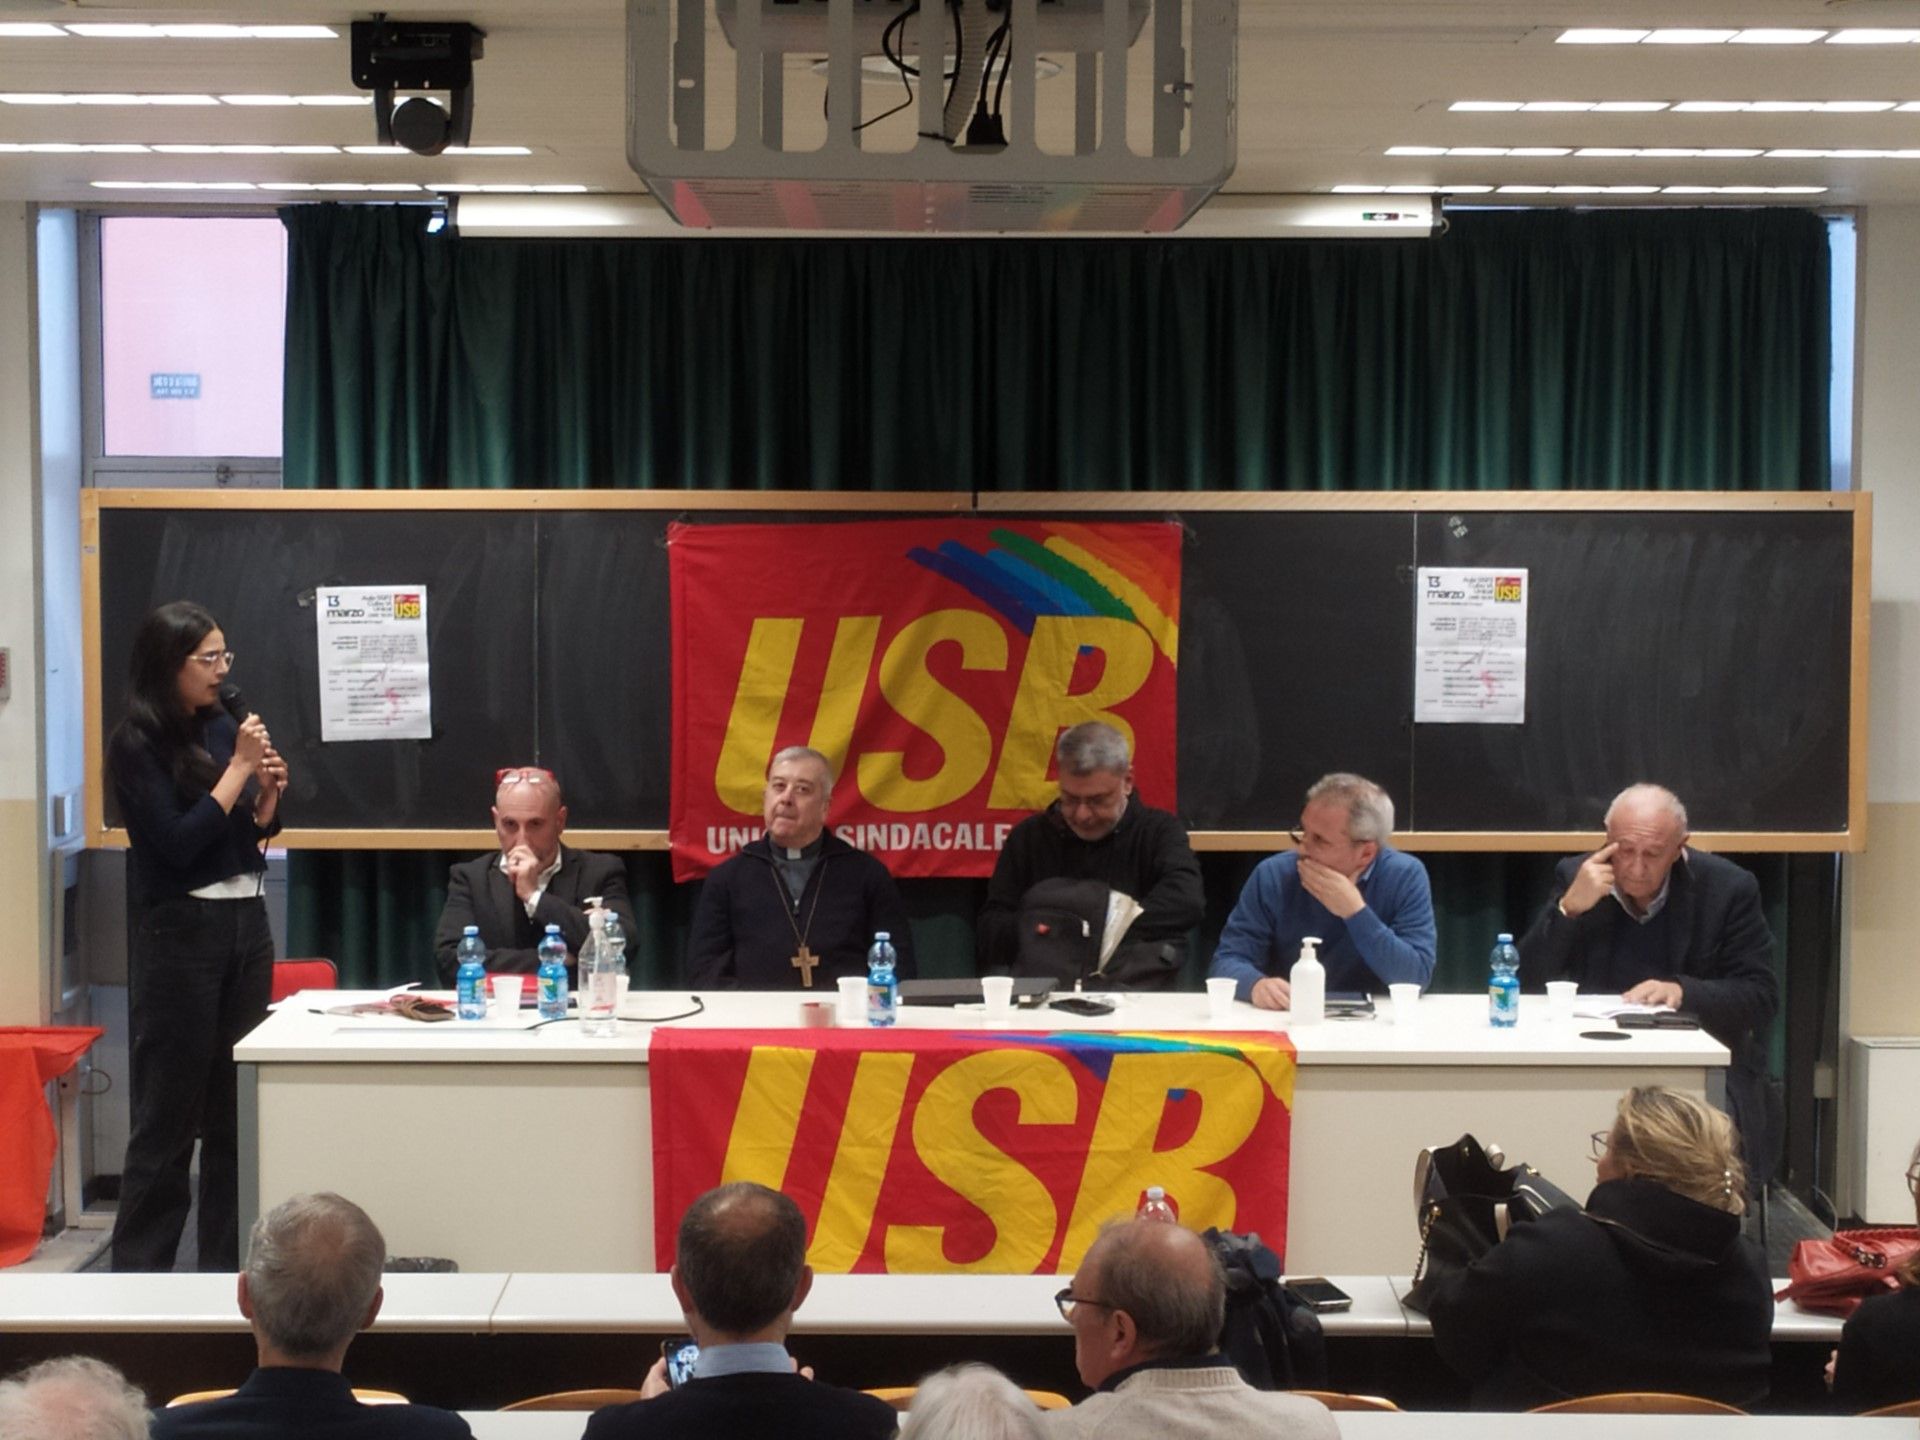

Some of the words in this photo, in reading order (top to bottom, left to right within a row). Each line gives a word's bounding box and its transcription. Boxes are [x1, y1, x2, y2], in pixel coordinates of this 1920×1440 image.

[1427, 576, 1441, 588] 13
[327, 595, 340, 607] 13
[1427, 590, 1465, 599] marzo
[1496, 585, 1520, 601] USB
[327, 609, 365, 618] marzo
[395, 602, 420, 618] USB
[715, 608, 1154, 817] USB
[706, 826, 765, 855] UNI
[720, 1045, 1265, 1275] USB
